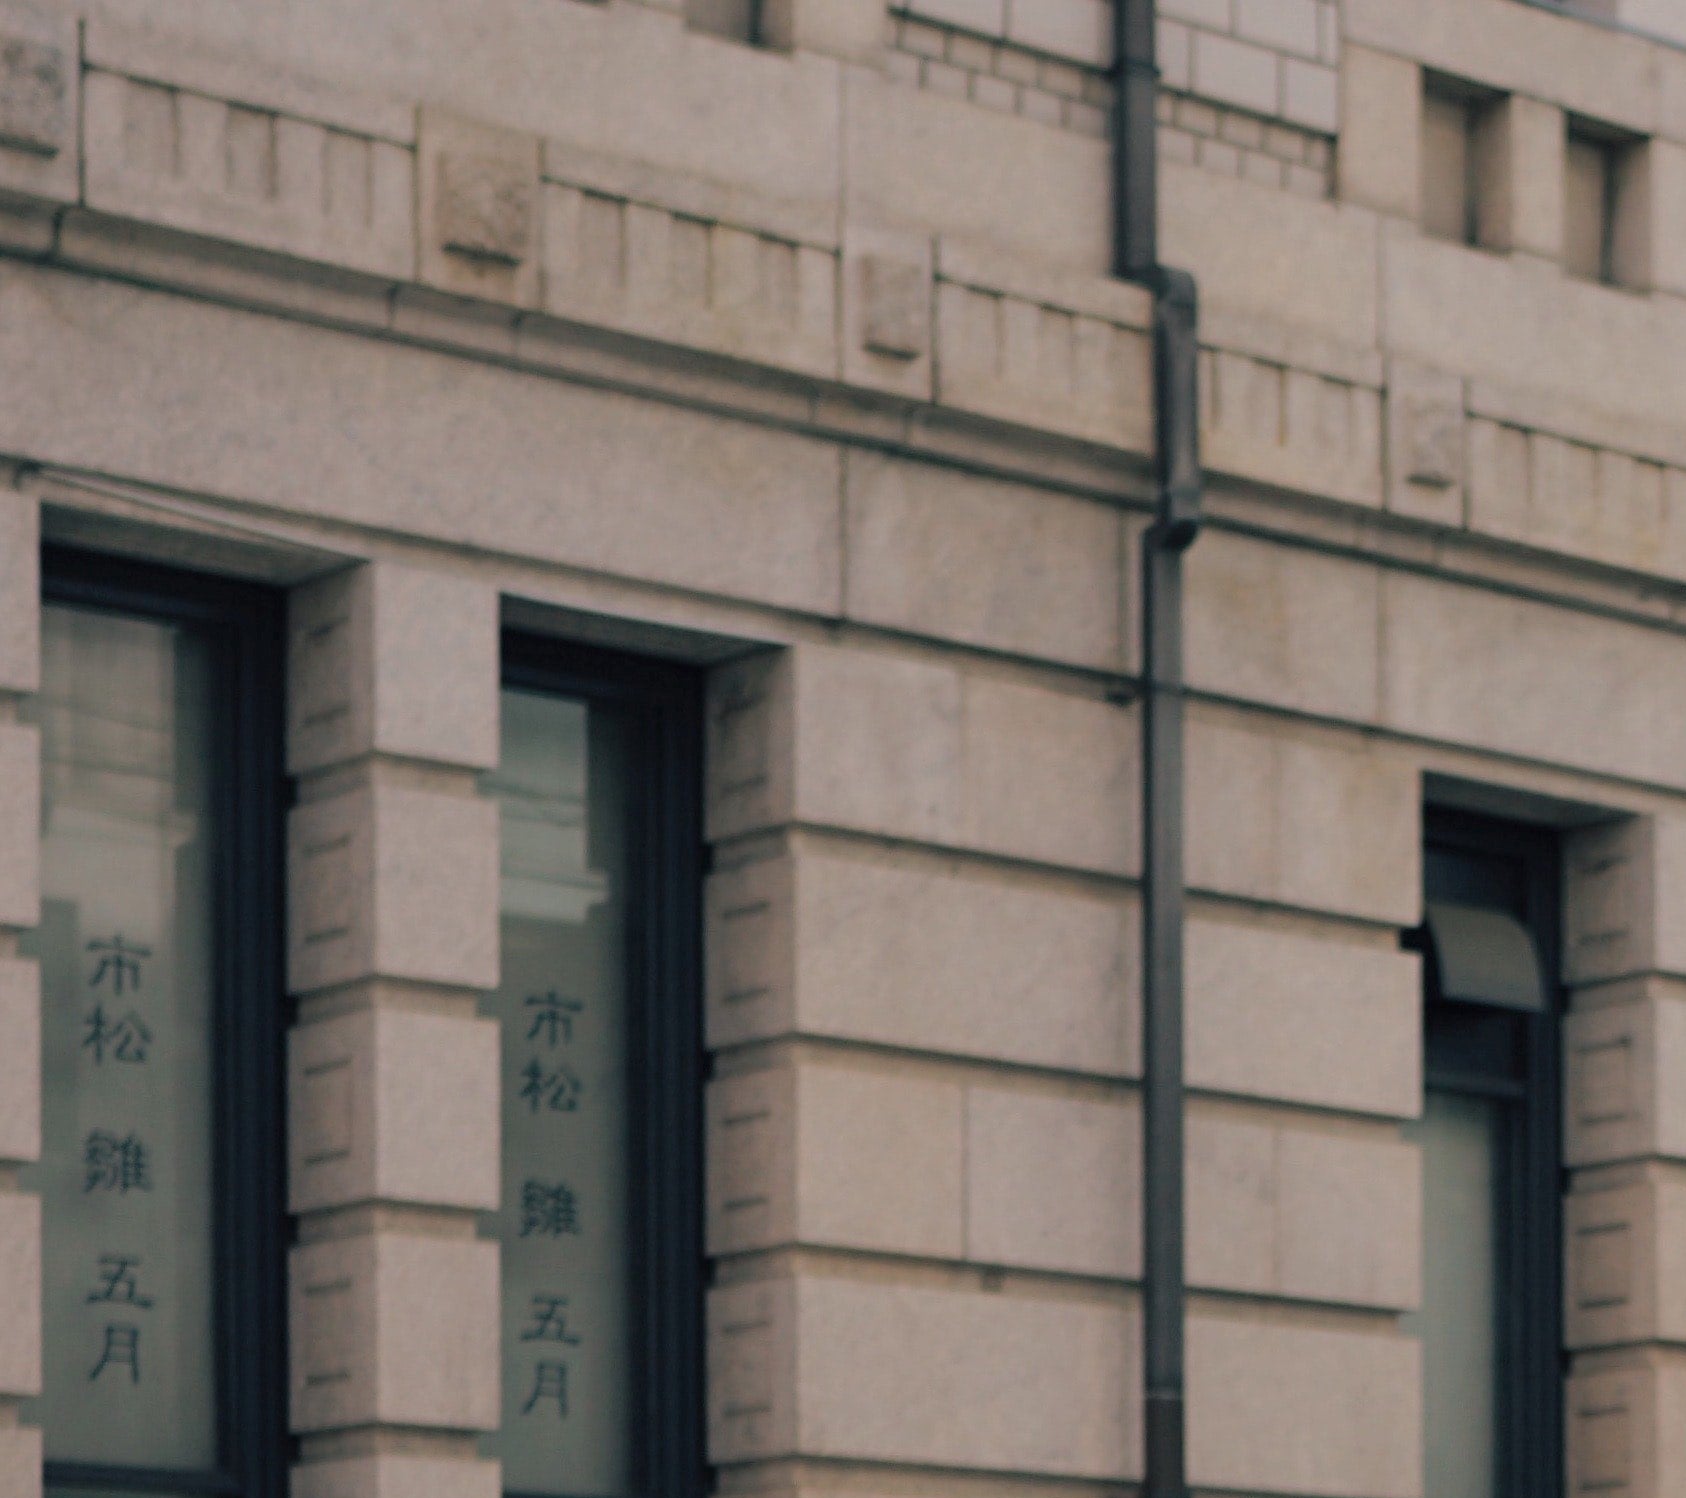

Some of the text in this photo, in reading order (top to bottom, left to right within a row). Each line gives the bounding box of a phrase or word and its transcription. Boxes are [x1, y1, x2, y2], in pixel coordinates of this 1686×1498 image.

[83, 932, 152, 1065] 市松
[520, 990, 583, 1113] 市松
[87, 1255, 154, 1385] 五月
[519, 1296, 581, 1419] 五月
